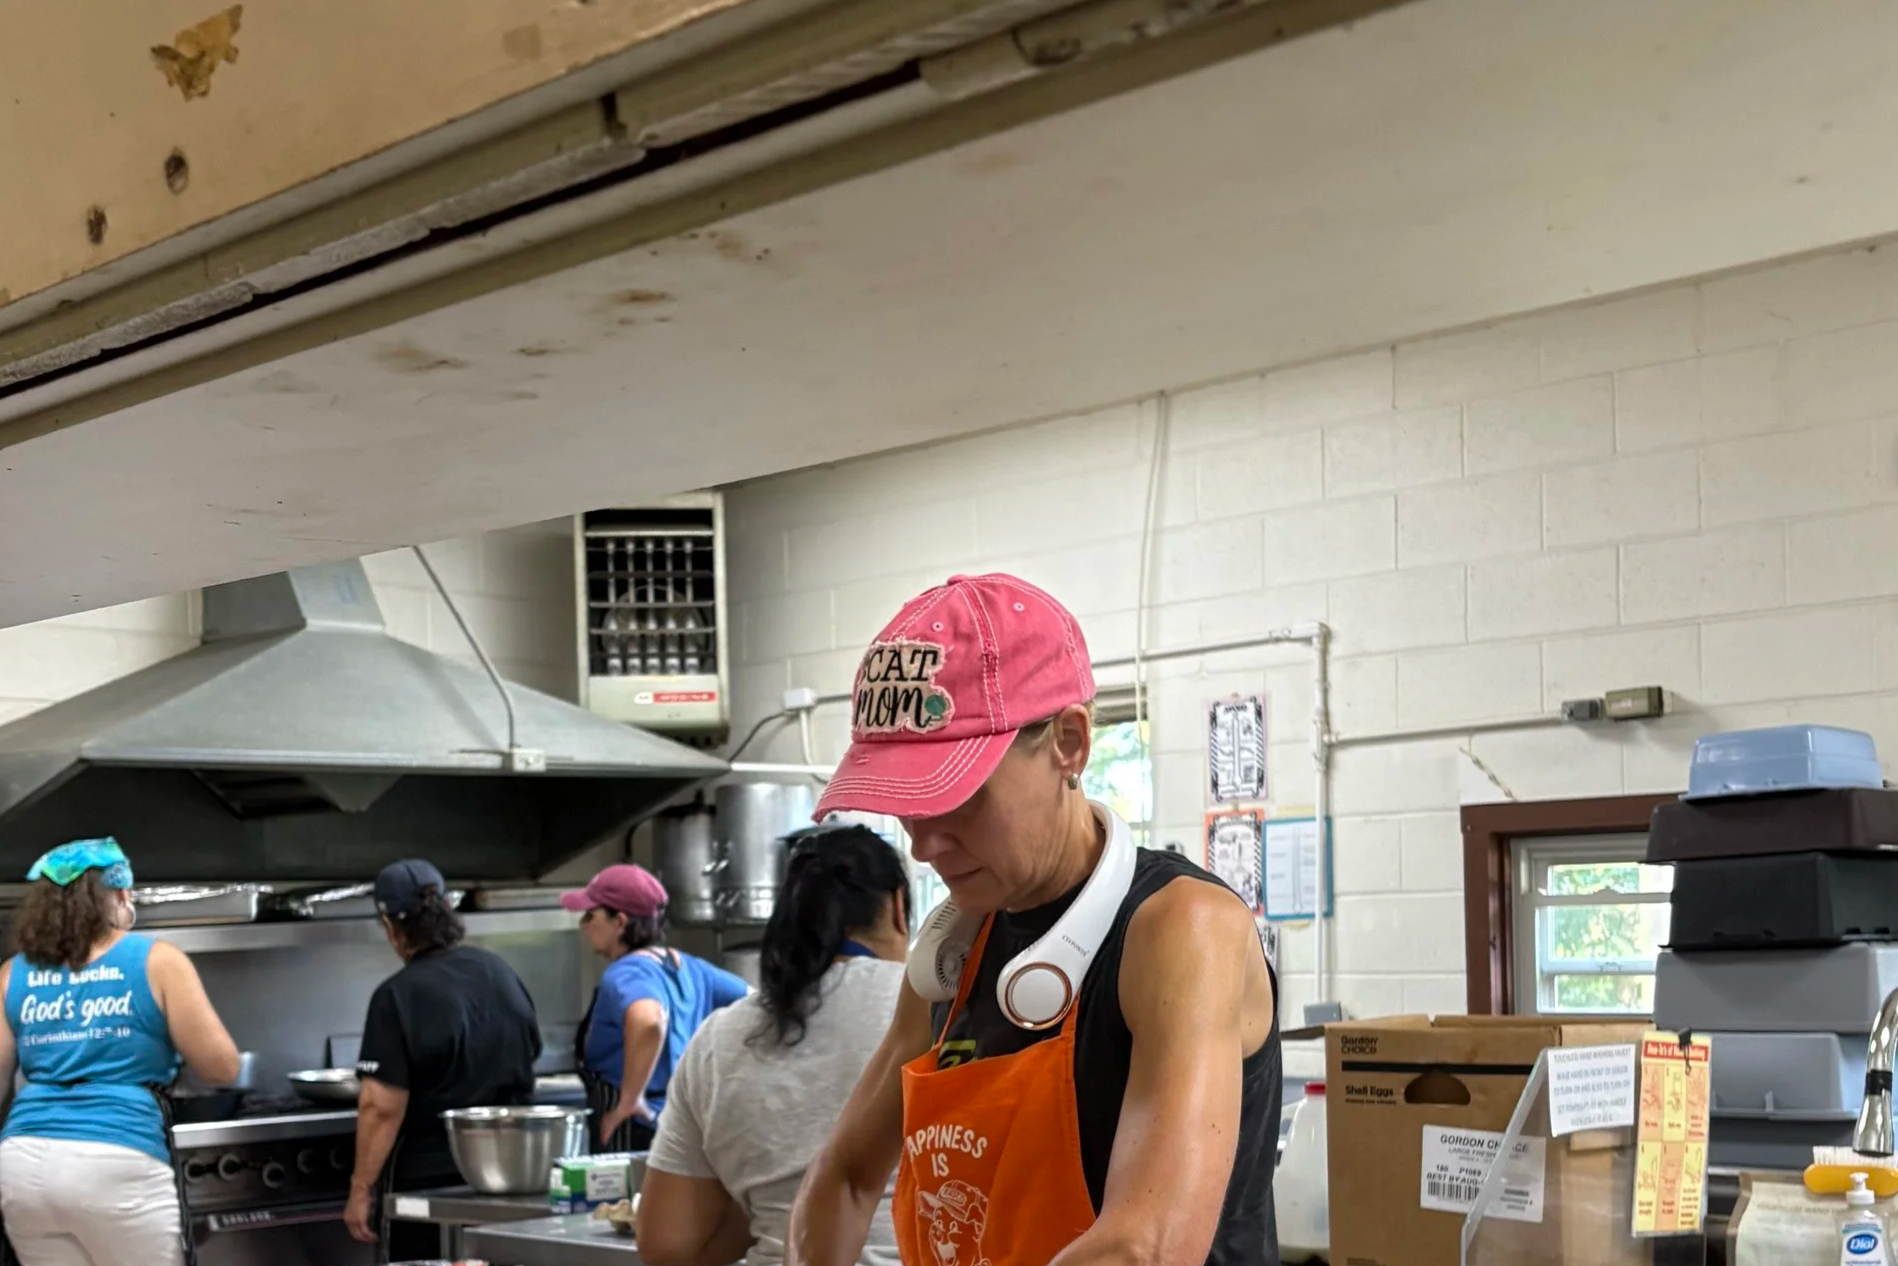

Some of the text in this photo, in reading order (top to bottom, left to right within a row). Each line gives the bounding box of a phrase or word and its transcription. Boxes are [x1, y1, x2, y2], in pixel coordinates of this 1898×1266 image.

[867, 649, 938, 682] CAT
[27, 969, 62, 988] Life
[21, 990, 76, 1024] God's
[1345, 1085, 1394, 1098] Shell Eggs
[906, 1123, 988, 1163] APPINESS
[1440, 1133, 1485, 1149] GORDON
[1448, 1147, 1471, 1156] LARGE
[931, 1152, 950, 1178] IS
[1426, 1172, 1447, 1181] BEST
[1448, 1175, 1459, 1183] BY
[1850, 1238, 1875, 1249] Dial
